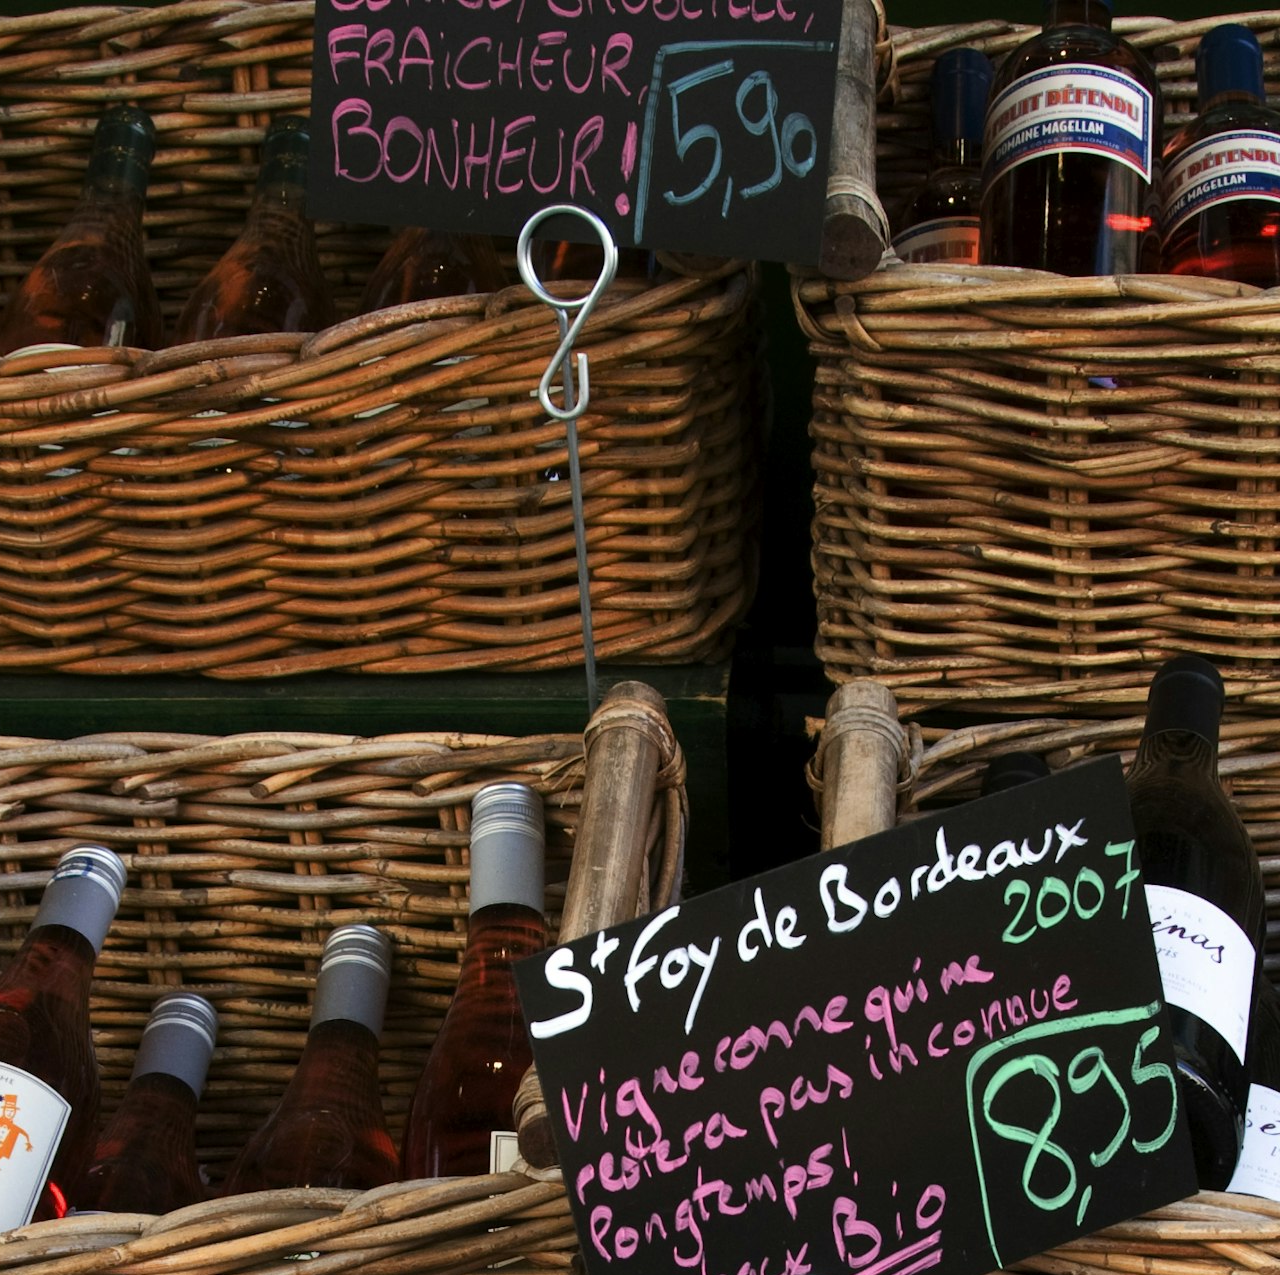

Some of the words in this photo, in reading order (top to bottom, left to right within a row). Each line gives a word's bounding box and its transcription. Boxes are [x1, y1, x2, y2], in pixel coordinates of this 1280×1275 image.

[662, 59, 819, 218] 5,90
[995, 124, 1040, 160] DOMAINE
[1041, 119, 1105, 137] MAGELLAN
[1044, 82, 1140, 123] DÉFENDU
[1187, 173, 1247, 205] MAGELLAN
[737, 886, 808, 963] de
[819, 817, 1089, 934] Bordeaux
[1001, 839, 1142, 944] 2007
[1150, 915, 1227, 964] énas
[759, 1063, 854, 1149] pas
[981, 1026, 1179, 1227] 8,95
